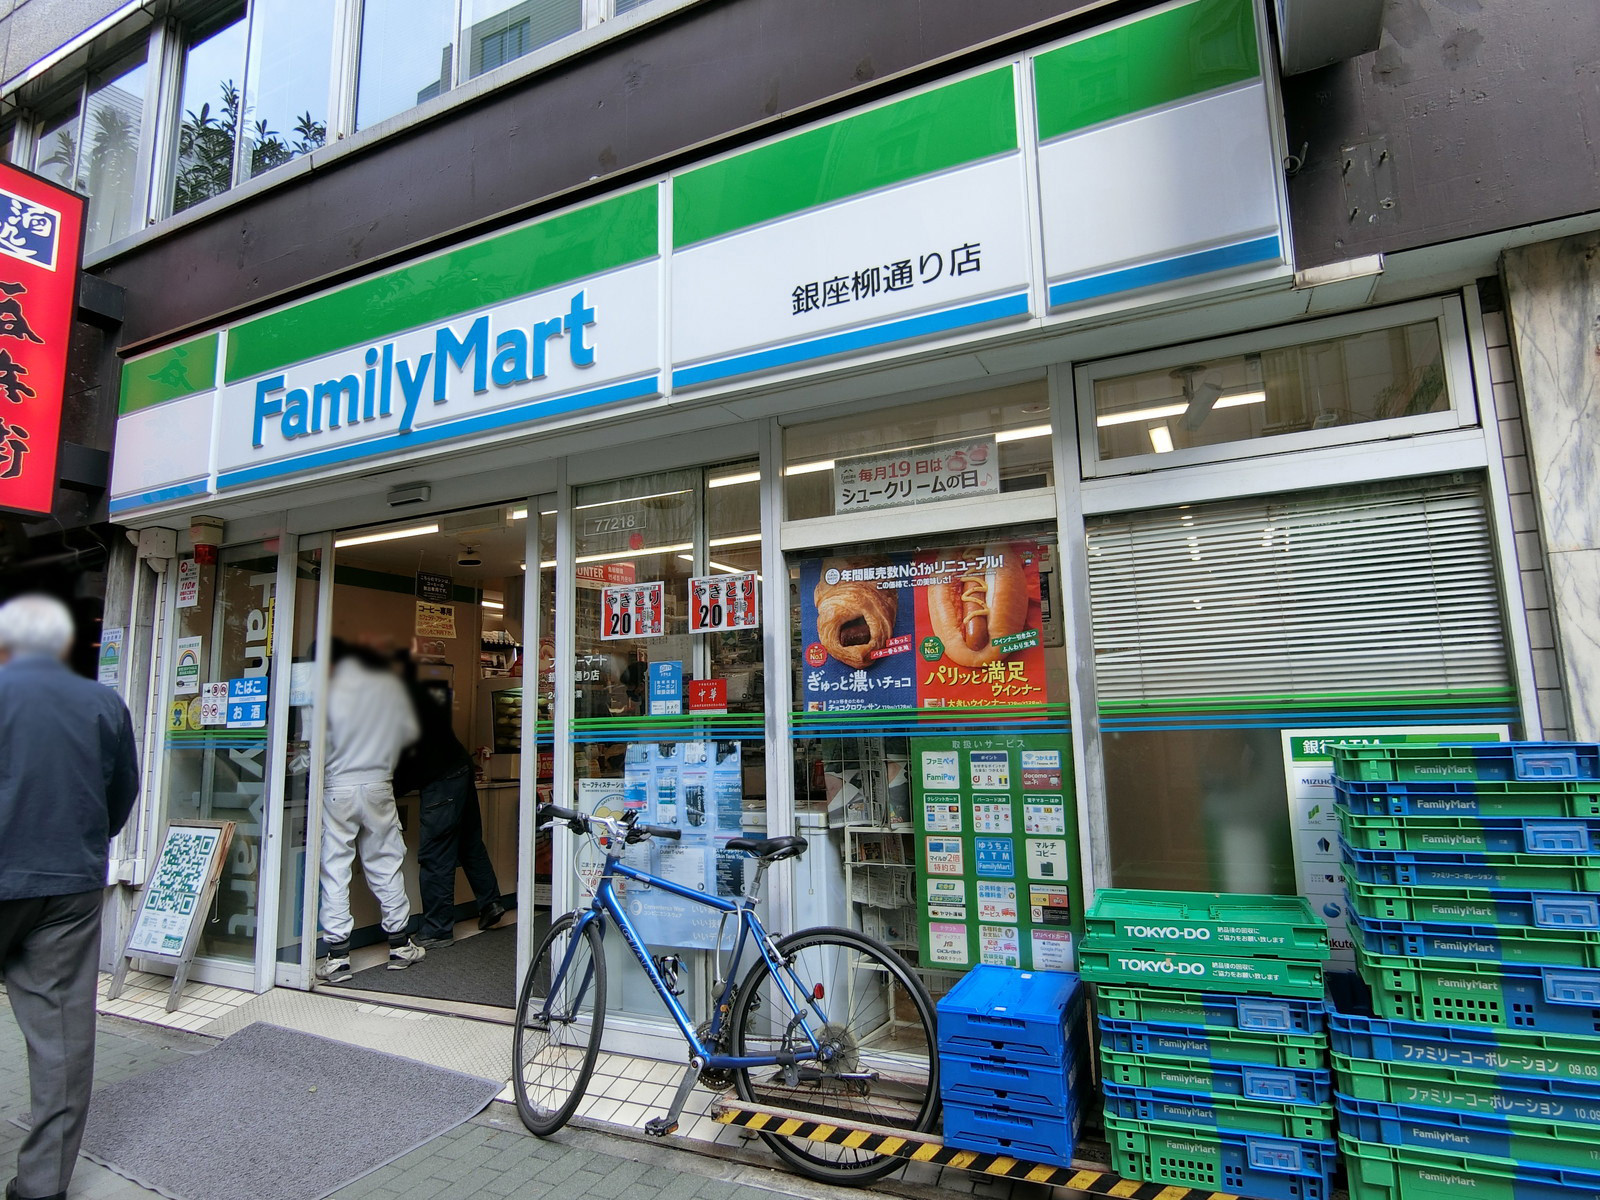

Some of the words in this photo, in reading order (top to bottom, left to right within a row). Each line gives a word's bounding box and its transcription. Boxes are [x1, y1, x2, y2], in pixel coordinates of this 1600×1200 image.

[792, 243, 981, 316] 銀座柳通り店
[252, 289, 597, 449] FamilyMart
[858, 458, 943, 483] 毎月19日は
[842, 470, 979, 506] シュークリームの日
[595, 514, 636, 533] 77218
[575, 566, 604, 579] UNTER
[694, 582, 753, 600] やきとり
[606, 591, 660, 610] やきとり
[699, 604, 722, 627] 20
[610, 612, 631, 634] 20
[924, 660, 1028, 686] パリッと満足
[235, 680, 262, 695] たばこ
[807, 669, 912, 692] ぎゅっと濃いチョコ
[991, 682, 1041, 697] ウインナー
[951, 739, 1026, 749] 取扱いサービス
[228, 571, 278, 938] FamyMart
[926, 757, 955, 766] ファミペイ
[1414, 764, 1473, 776] FamilyMart
[926, 773, 956, 782] FamiPay
[581, 781, 625, 789] セーフティステーショ
[1417, 799, 1476, 811] FamilyMart
[978, 842, 1010, 850] ゆうちょ
[1422, 834, 1482, 846] FamilyMart
[929, 853, 961, 863] マイルが2倍
[1035, 850, 1058, 858] コピー
[933, 863, 957, 872] 特約店
[979, 863, 1011, 872] FamilyMart
[1432, 904, 1492, 917] FamilyMart
[1123, 925, 1211, 940] TOKYO-DO
[1217, 935, 1285, 944] ご協力をお願い致します
[1434, 940, 1495, 953] FamilyMart
[1117, 958, 1205, 976] TOKYO-DO
[1212, 970, 1280, 981] ご協力をお願い致します
[1437, 977, 1498, 991] FamilyMart
[1158, 1038, 1208, 1051] FamilyMart
[1402, 1044, 1560, 1074] ファミリーコーポレーション
[1568, 1063, 1598, 1077] 09.03
[1161, 1071, 1210, 1085] FamilyMart
[1406, 1086, 1564, 1116] ファミリーコーポレーション
[1163, 1104, 1213, 1119] FamilyMart
[1412, 1127, 1471, 1144] FamilyMart
[1166, 1140, 1216, 1154] FamilyMart
[1418, 1170, 1476, 1187] FamilyMart
